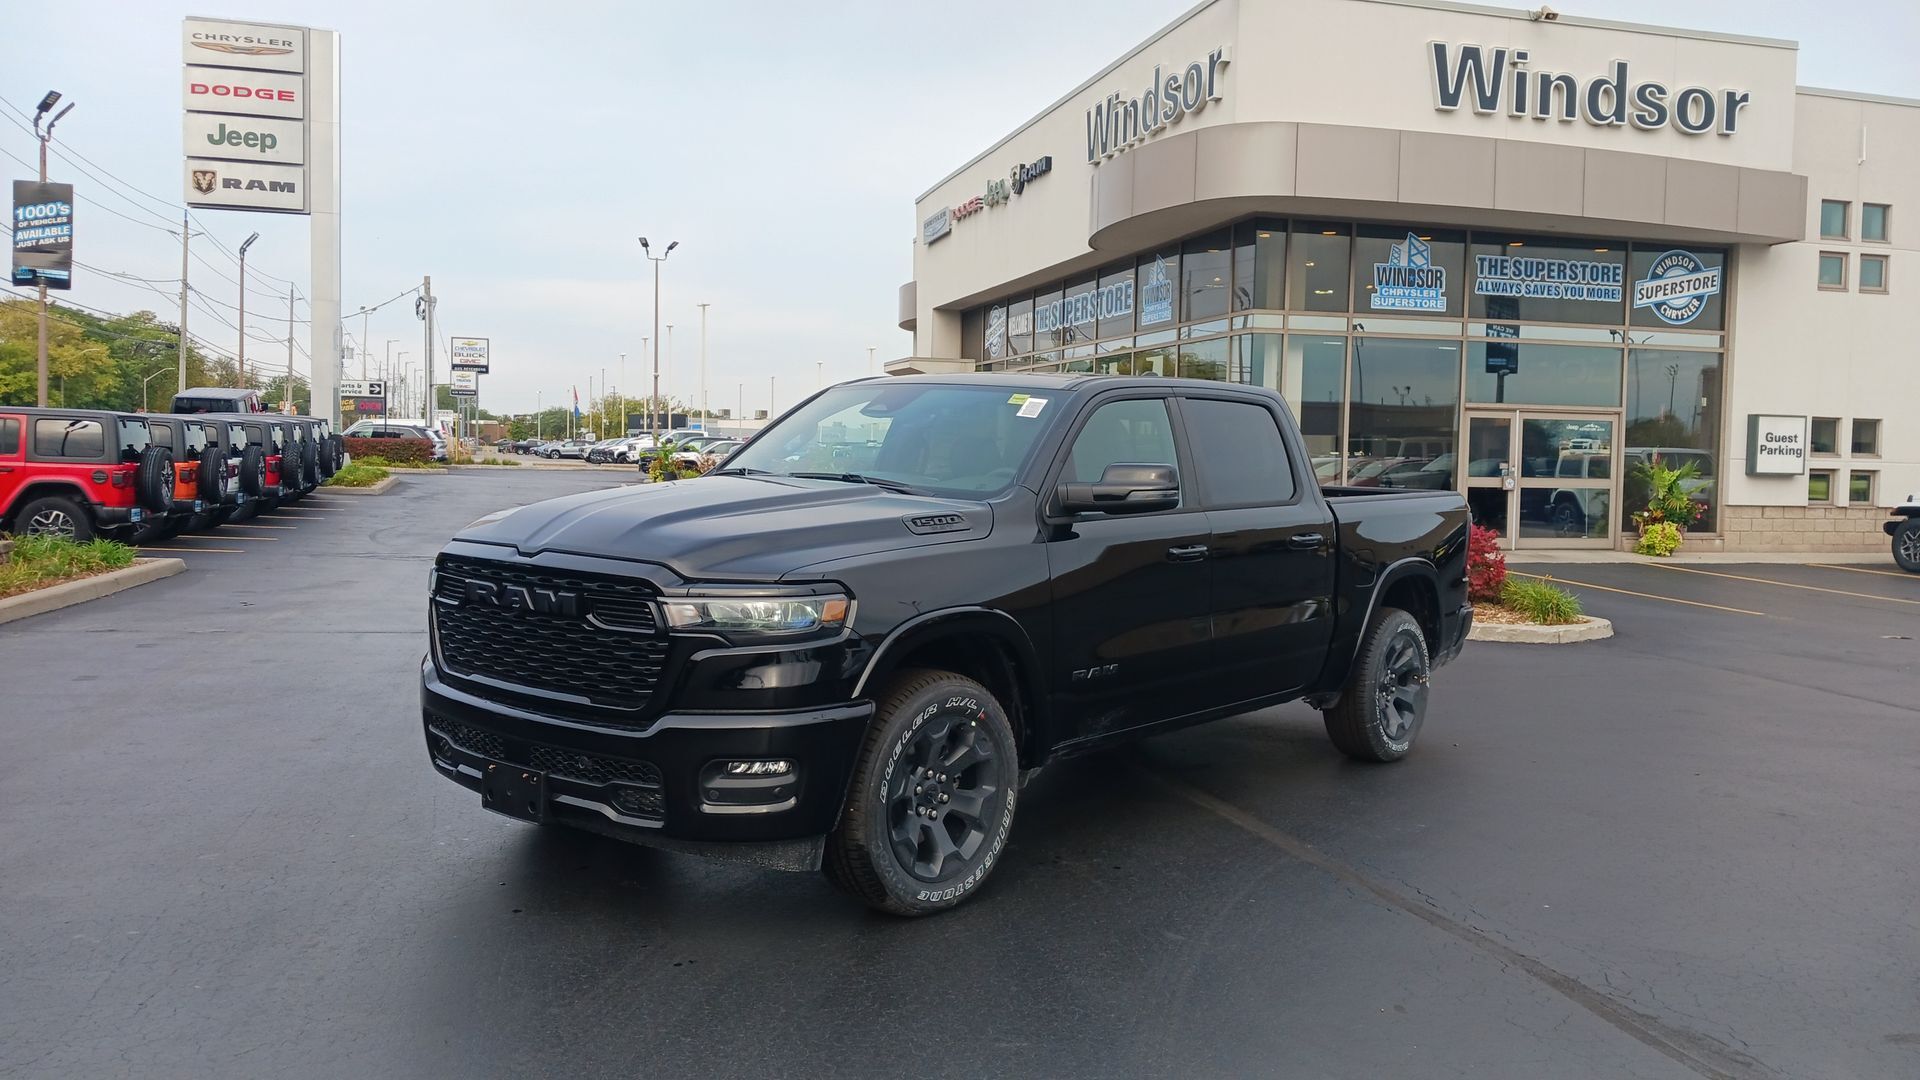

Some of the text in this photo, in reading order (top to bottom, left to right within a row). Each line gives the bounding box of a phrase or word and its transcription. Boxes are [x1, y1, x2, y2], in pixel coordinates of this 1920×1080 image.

[192, 32, 294, 47] CHRYSLER
[190, 83, 295, 102] DODGE
[1429, 40, 1750, 136] Windsor
[1086, 45, 1228, 165] Windsor
[206, 123, 277, 153] Jeep
[1020, 156, 1052, 183] RAM
[222, 177, 296, 193] RAM
[17, 202, 70, 220] 1000's
[18, 216, 68, 228] OF VEHICLES
[16, 226, 70, 240] AVAILABLE
[16, 239, 37, 248] JUST
[39, 237, 56, 246] ASK
[1477, 257, 1622, 283] THE SUPERSTORE
[1655, 255, 1695, 275] WINDSOR
[1376, 266, 1443, 289] WINDSOR
[1382, 287, 1437, 298] CHRYSLER
[1477, 280, 1621, 300] ALWAYS SAVES YOU MORE!
[1638, 275, 1717, 301] SUPERSTORE
[1036, 307, 1050, 331] THE
[1051, 281, 1132, 330] SUPERSTORE
[1374, 297, 1445, 309] SUPERSTORE
[1660, 298, 1701, 320] CHRYSLER
[1765, 432, 1798, 443] Guest
[1760, 444, 1802, 458] Parking
[911, 516, 962, 528] 1500
[464, 579, 579, 617] RAM
[879, 703, 938, 804] DUELER
